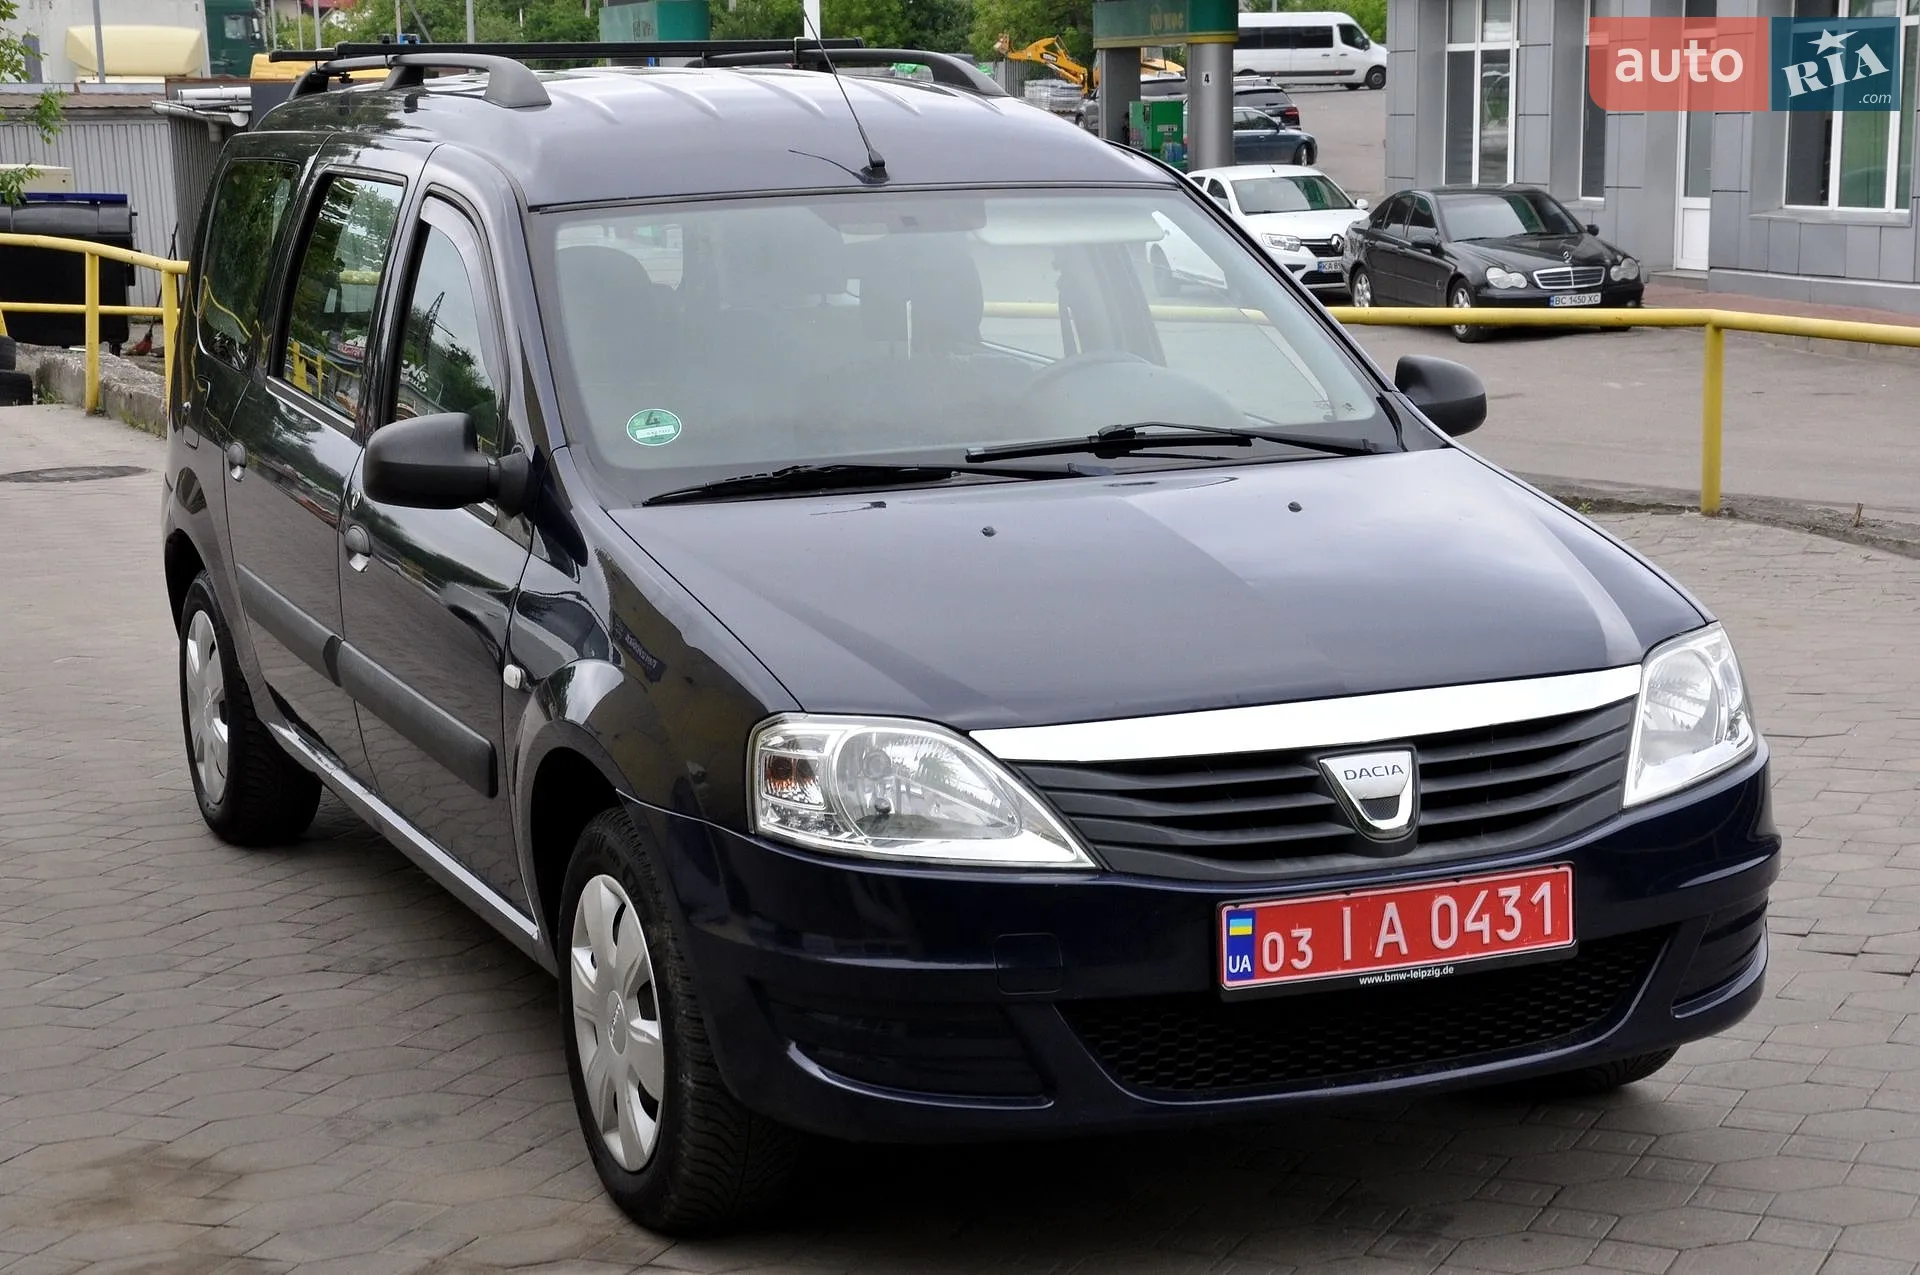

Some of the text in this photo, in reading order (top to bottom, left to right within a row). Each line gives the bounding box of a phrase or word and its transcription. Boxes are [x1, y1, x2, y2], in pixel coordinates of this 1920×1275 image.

[1204, 73, 1210, 84] 4
[1554, 296, 1566, 305] BC
[1570, 296, 1586, 304] 1450
[1588, 295, 1600, 304] XC
[1344, 764, 1404, 780] DACIA
[1262, 927, 1313, 973] 03
[1430, 881, 1552, 950] 0431
[1228, 954, 1252, 973] UA
[1359, 965, 1455, 985] www.bmw-leipzig.de
